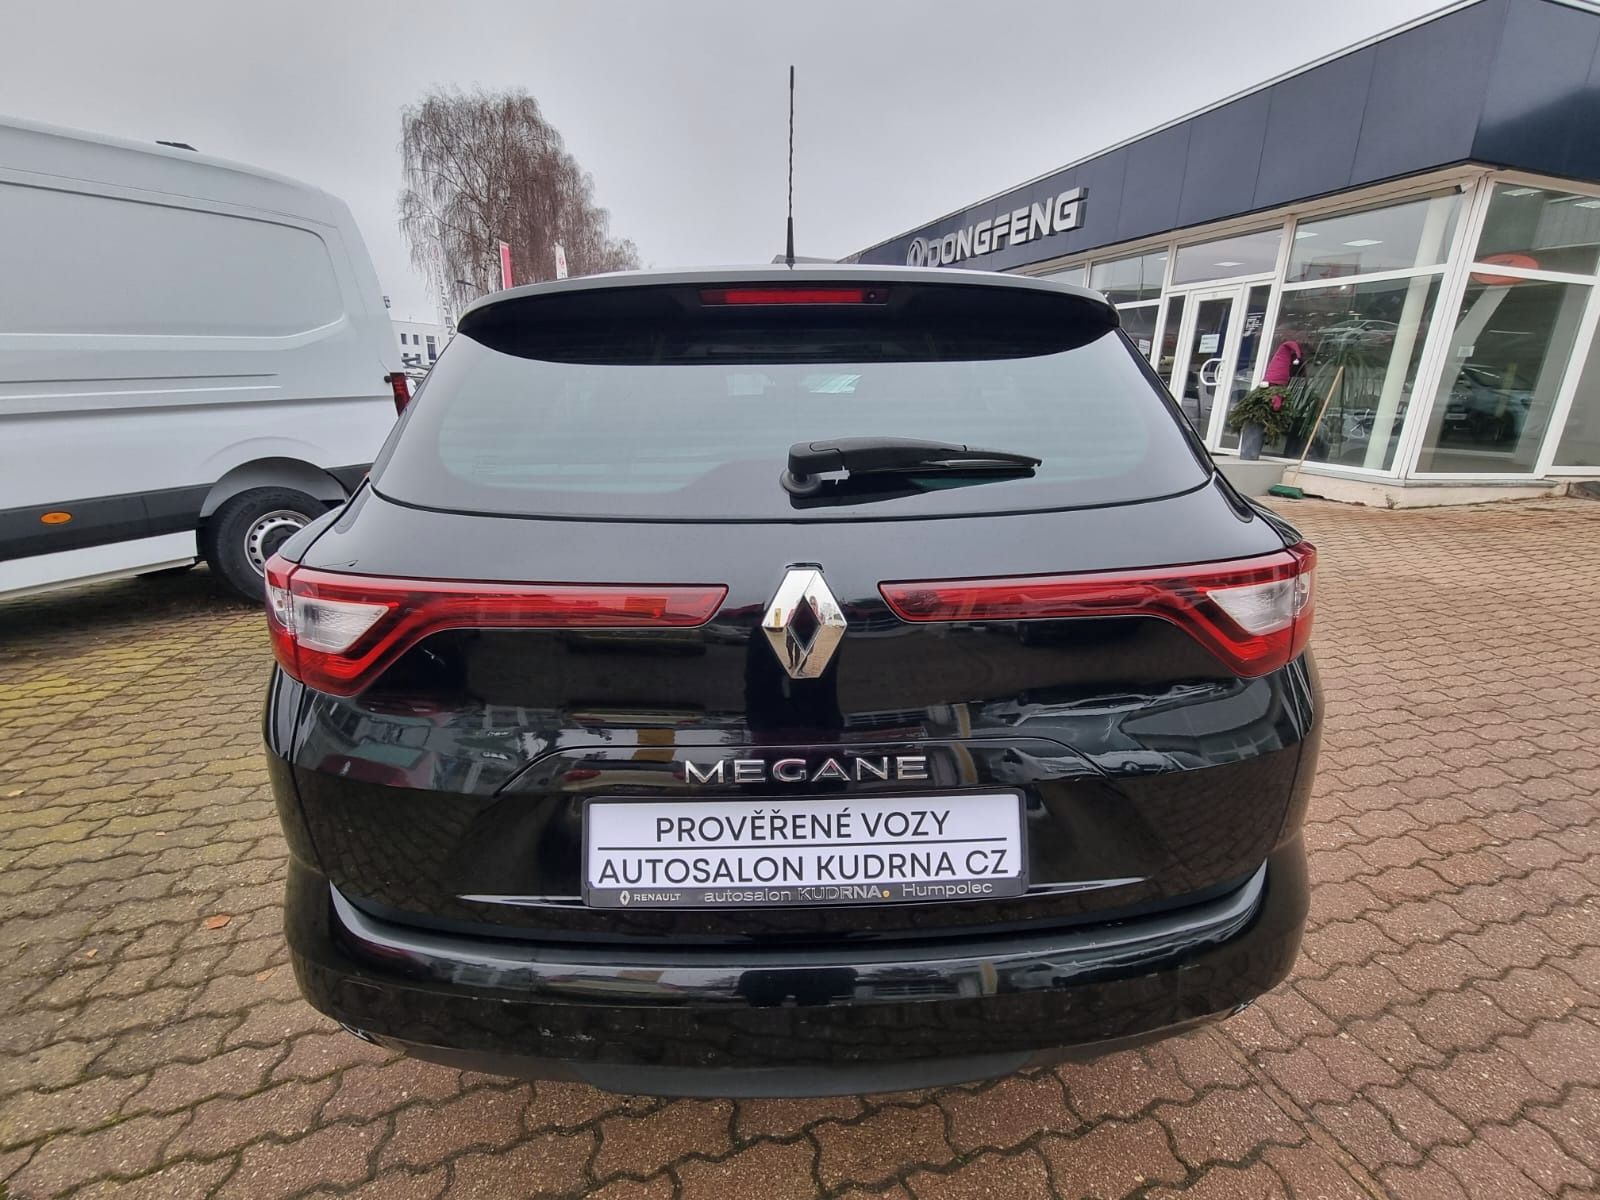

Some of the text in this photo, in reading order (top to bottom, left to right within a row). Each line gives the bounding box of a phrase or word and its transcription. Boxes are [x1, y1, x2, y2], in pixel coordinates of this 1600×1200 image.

[927, 186, 1089, 267] DONGFENG
[685, 756, 929, 784] MEGANE
[656, 807, 951, 842] PROVĚŘENÉ VOZY
[598, 849, 1008, 885] AUTOSALON KUDRNA CZ
[633, 893, 681, 902] RENAULT
[704, 889, 792, 902] autosalon
[902, 881, 994, 897] Humpolec
